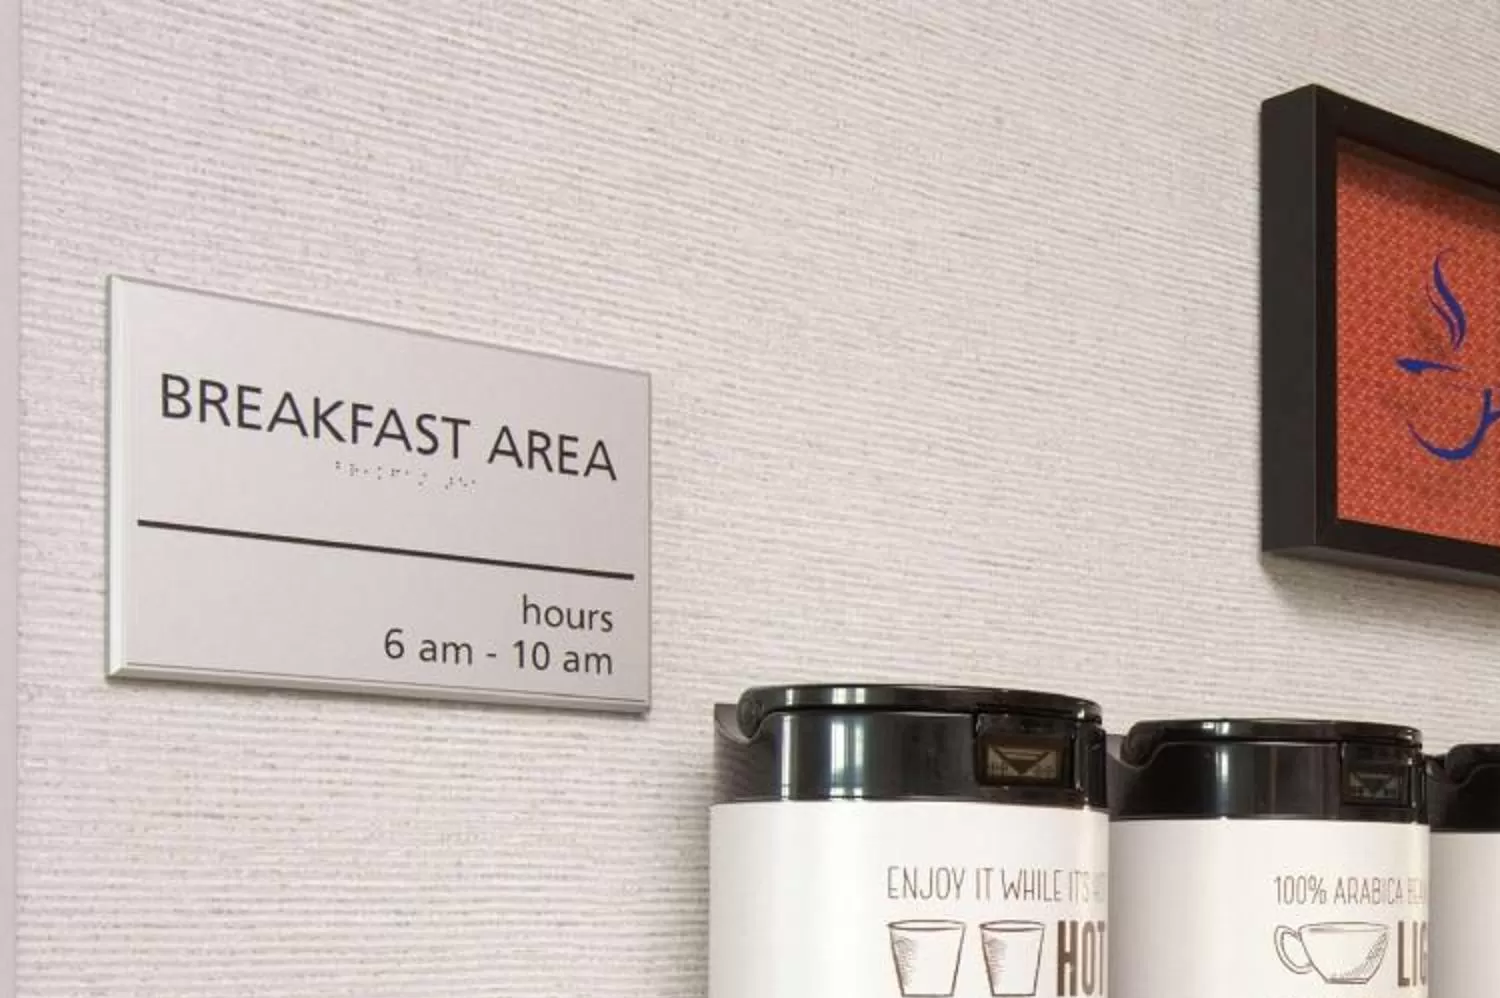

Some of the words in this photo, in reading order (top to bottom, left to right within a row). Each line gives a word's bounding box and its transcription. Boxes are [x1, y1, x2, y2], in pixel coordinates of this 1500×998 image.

[161, 372, 470, 459] BREAKFAST
[487, 424, 618, 481] AREA
[522, 594, 614, 633] hours
[384, 628, 405, 661] 6
[419, 637, 473, 665] am
[513, 639, 550, 671] 10
[563, 649, 613, 675] am
[887, 865, 966, 900] ENJOY
[976, 867, 994, 901] IT
[1001, 868, 1062, 902] WHILE
[1273, 874, 1328, 906] 100%
[1333, 876, 1403, 906] ARABICA
[1057, 920, 1105, 997] HOT
